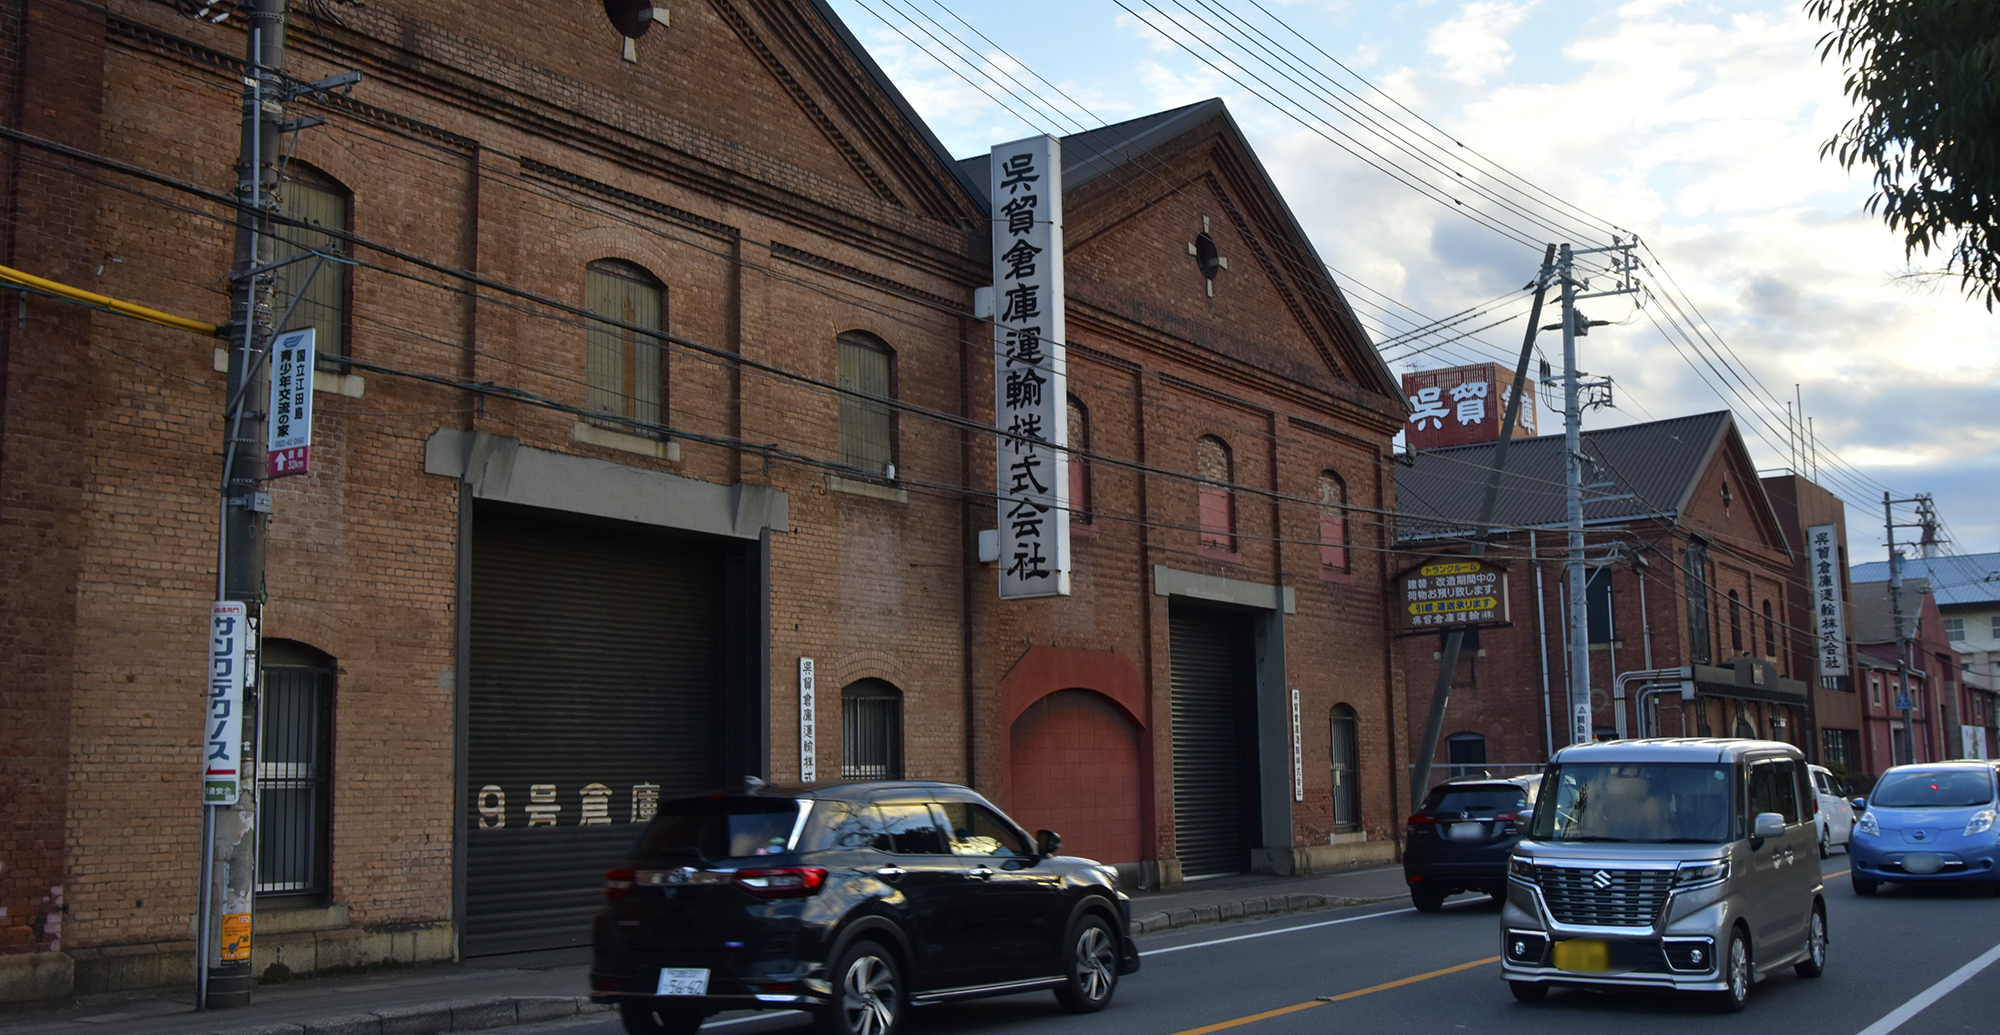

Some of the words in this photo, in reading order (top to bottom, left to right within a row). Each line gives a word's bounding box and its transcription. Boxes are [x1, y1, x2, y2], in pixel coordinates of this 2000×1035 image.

[277, 349, 292, 438] 青少年交流の家
[294, 349, 306, 420] 国立江田島
[1000, 153, 1050, 582] 呉貿倉庫運輸株式会社
[1409, 381, 1489, 432] 呉貿
[1426, 563, 1477, 574] トランクルーム
[1814, 532, 1841, 669] 呉貿倉庫運輸株式会社
[207, 616, 236, 761] サンワテクノス
[478, 781, 661, 830] 9号倉庫
